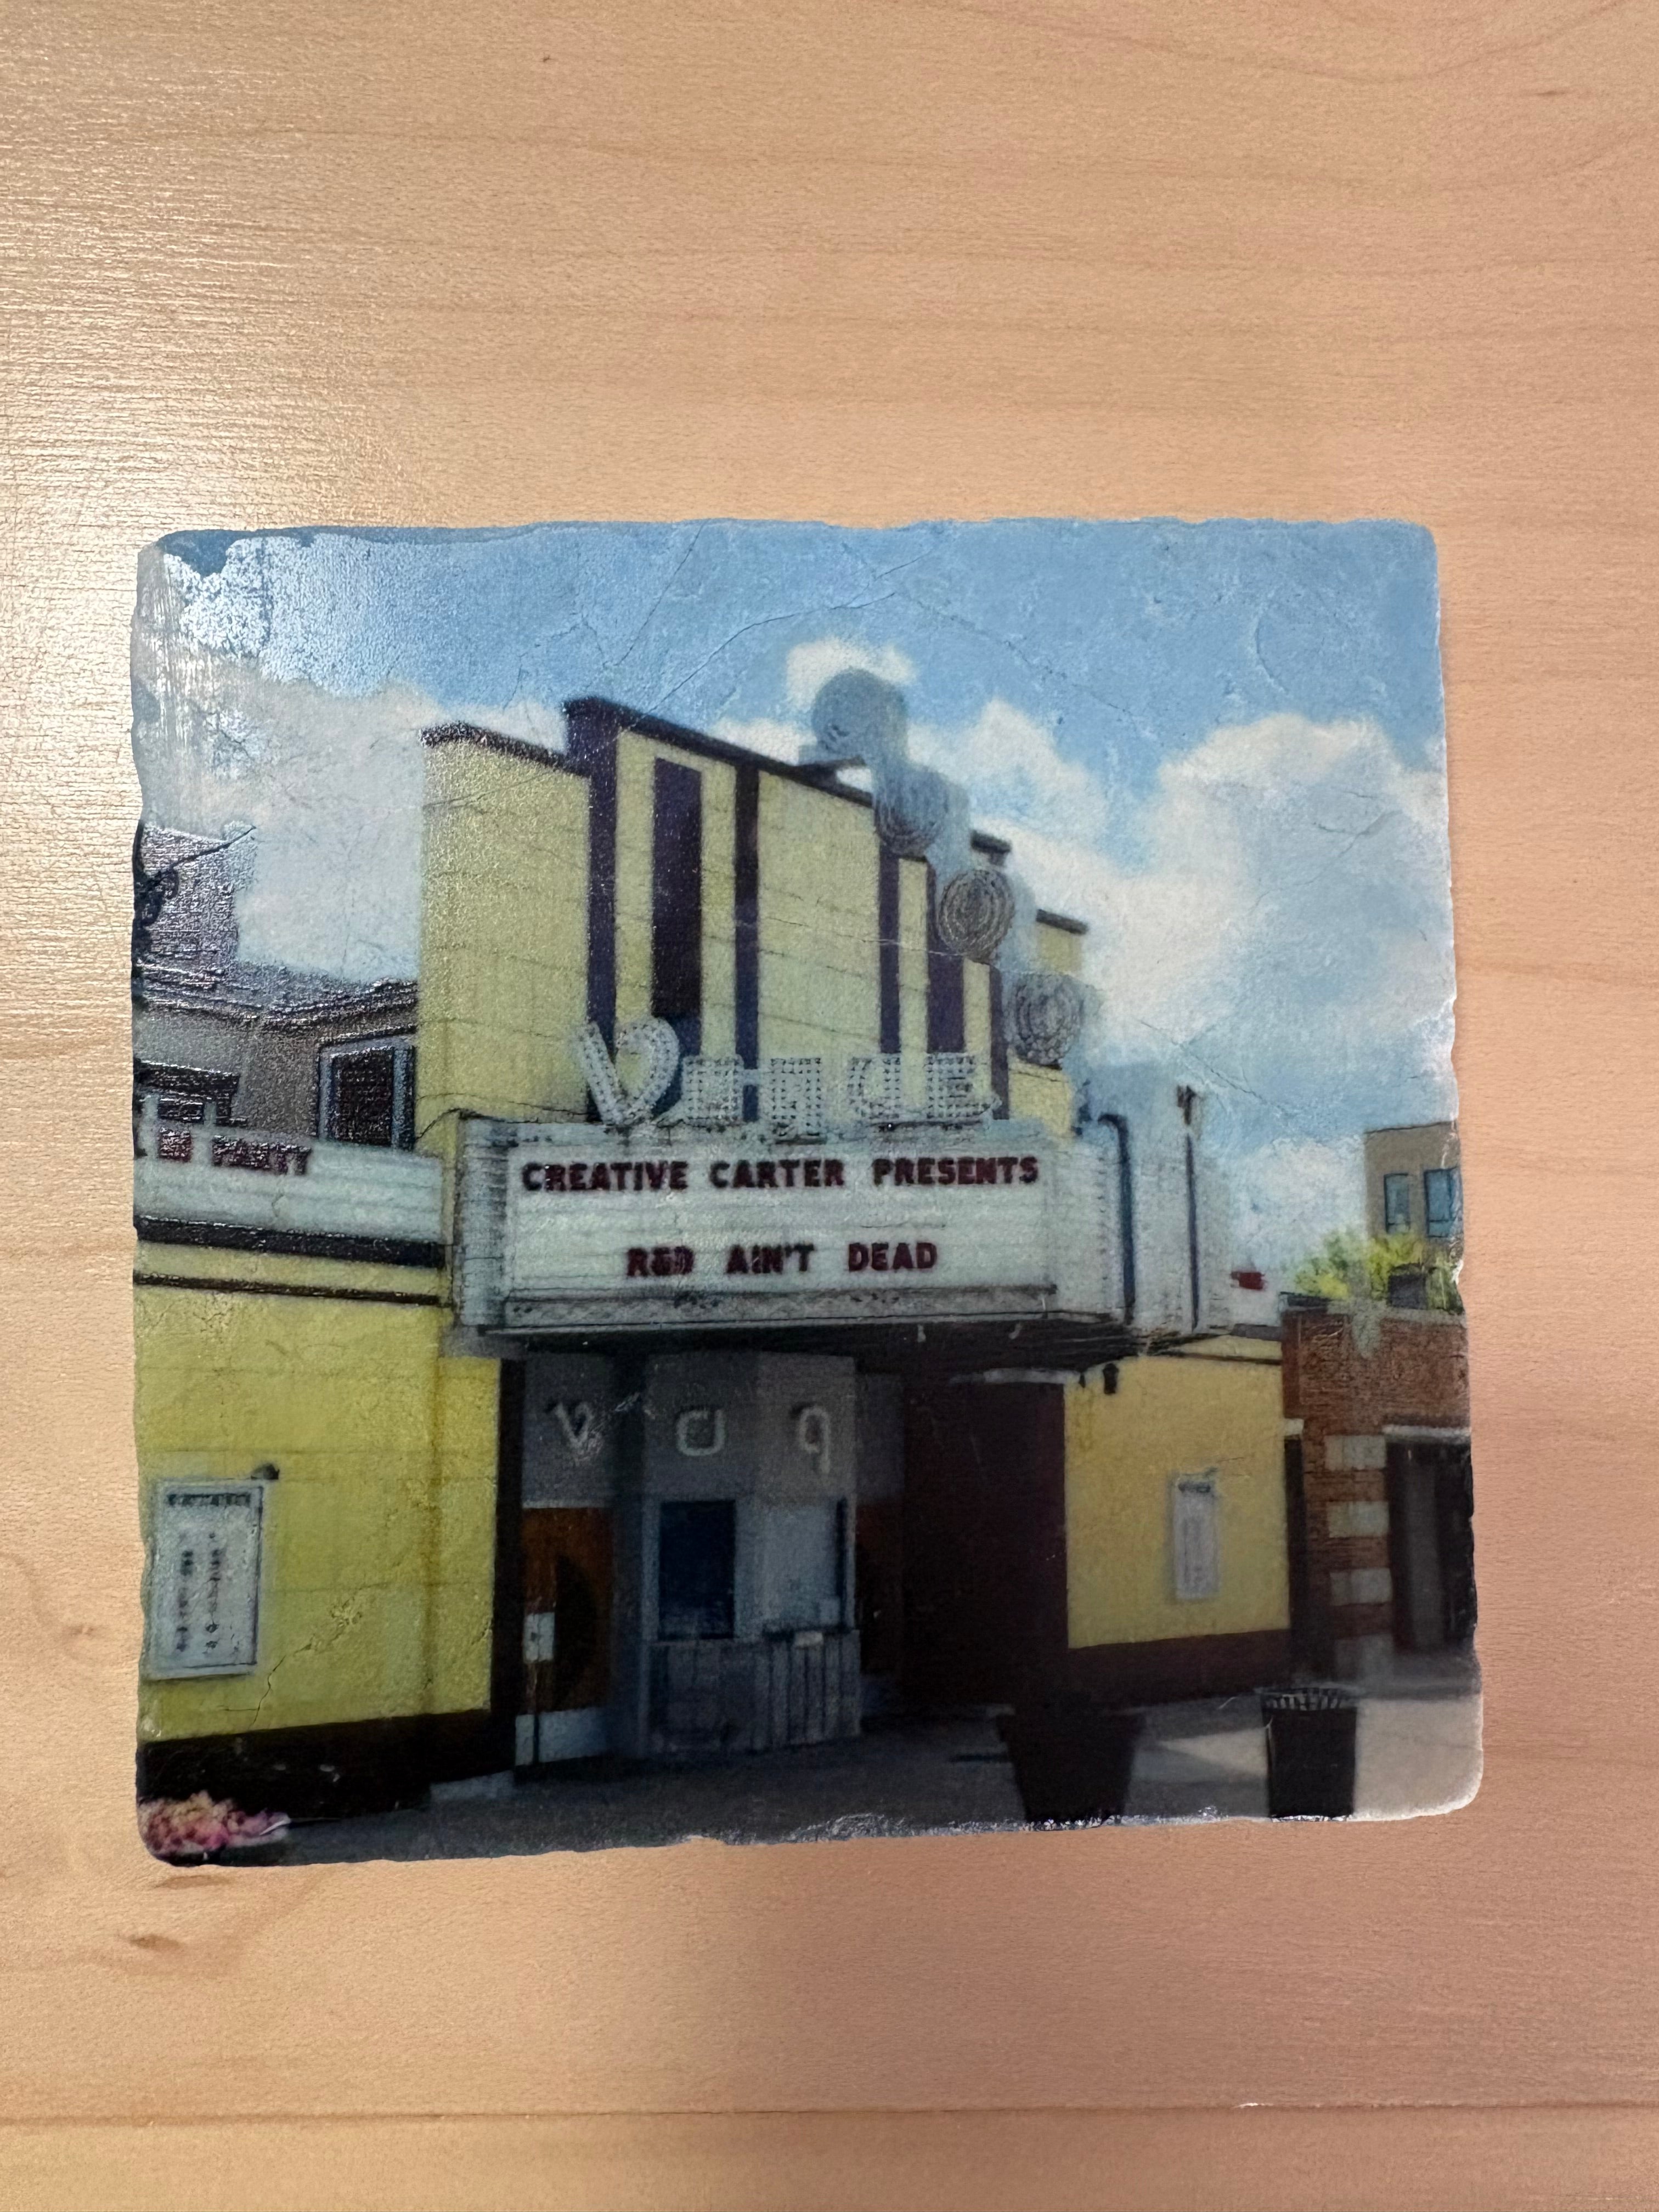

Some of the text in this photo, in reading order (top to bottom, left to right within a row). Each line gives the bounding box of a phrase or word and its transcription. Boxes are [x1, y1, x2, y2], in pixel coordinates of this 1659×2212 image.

[522, 1156, 1038, 1190] CREATIVE CARTER PRESENTS
[627, 1242, 938, 1277] RED AIN'T DEAD
